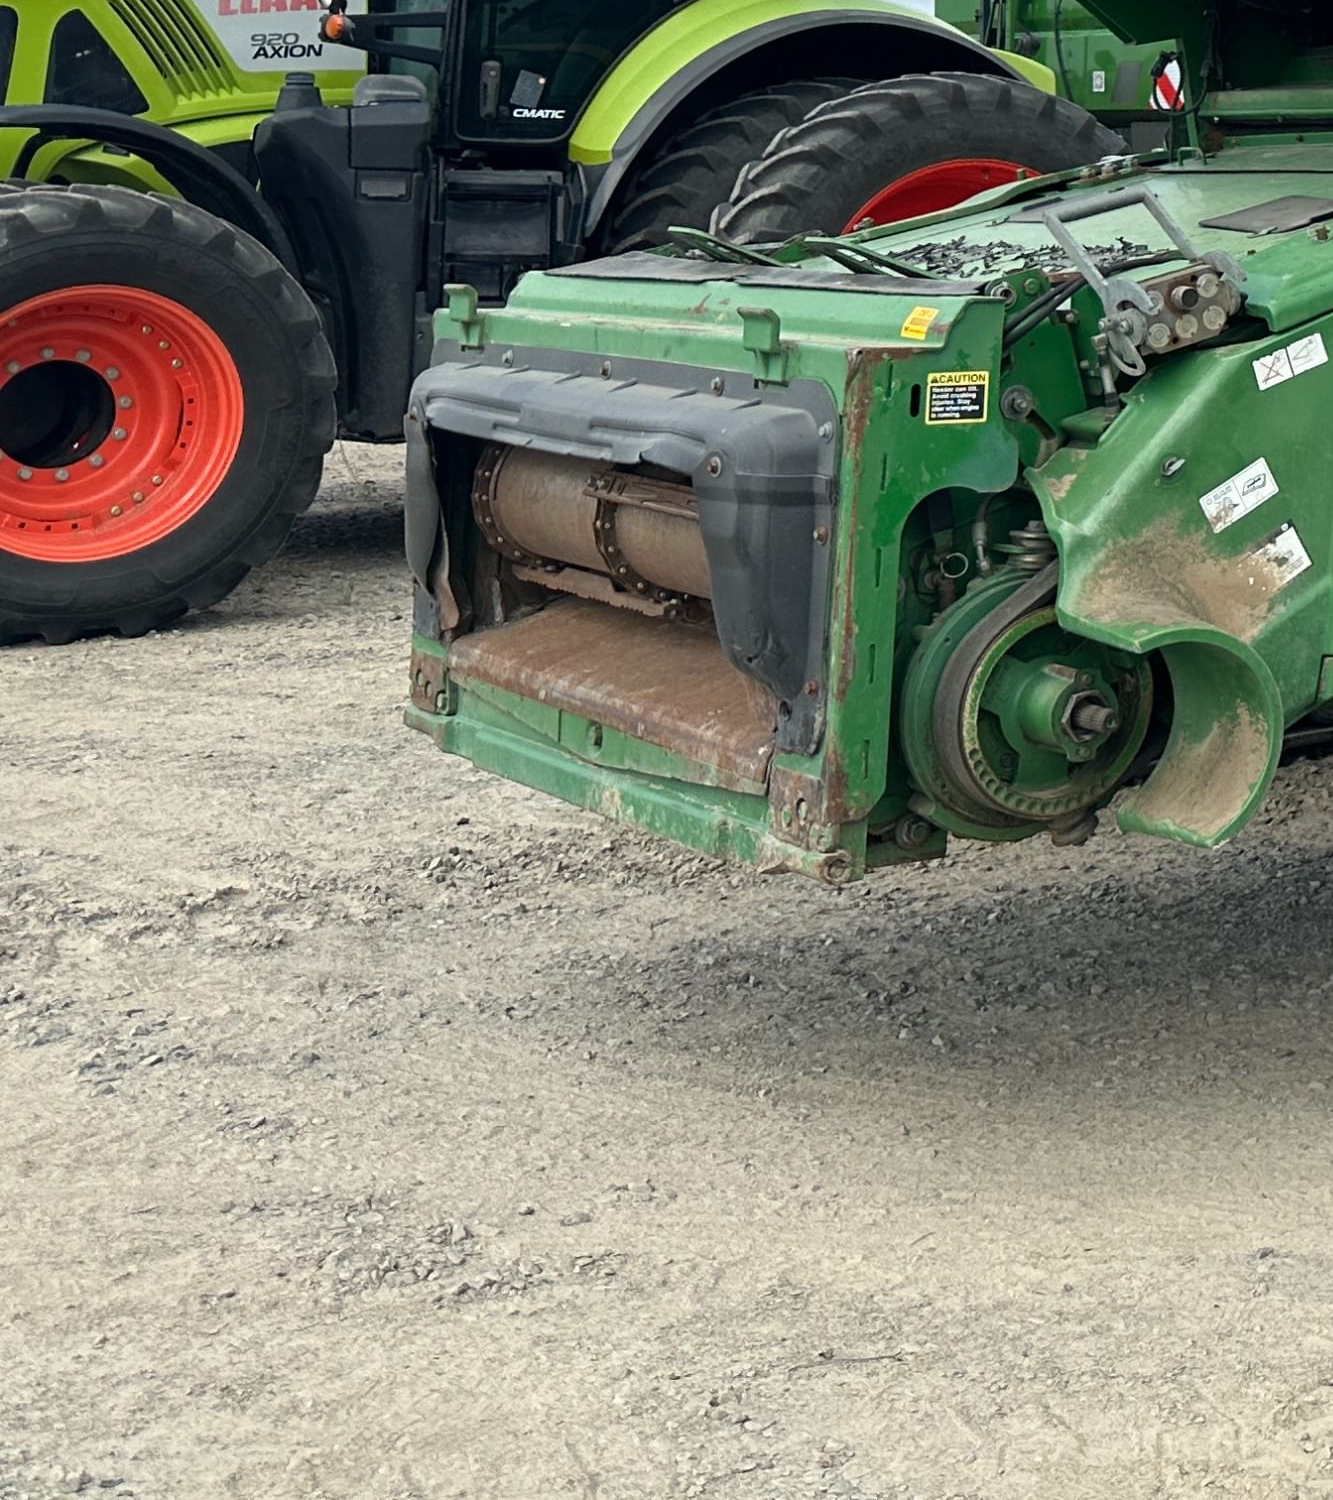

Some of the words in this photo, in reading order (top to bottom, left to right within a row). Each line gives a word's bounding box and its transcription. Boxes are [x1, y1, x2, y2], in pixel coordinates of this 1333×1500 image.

[251, 33, 299, 46] 920
[252, 44, 322, 59] AXION
[513, 109, 566, 118] CMATIC
[940, 374, 986, 383] CAUTION
